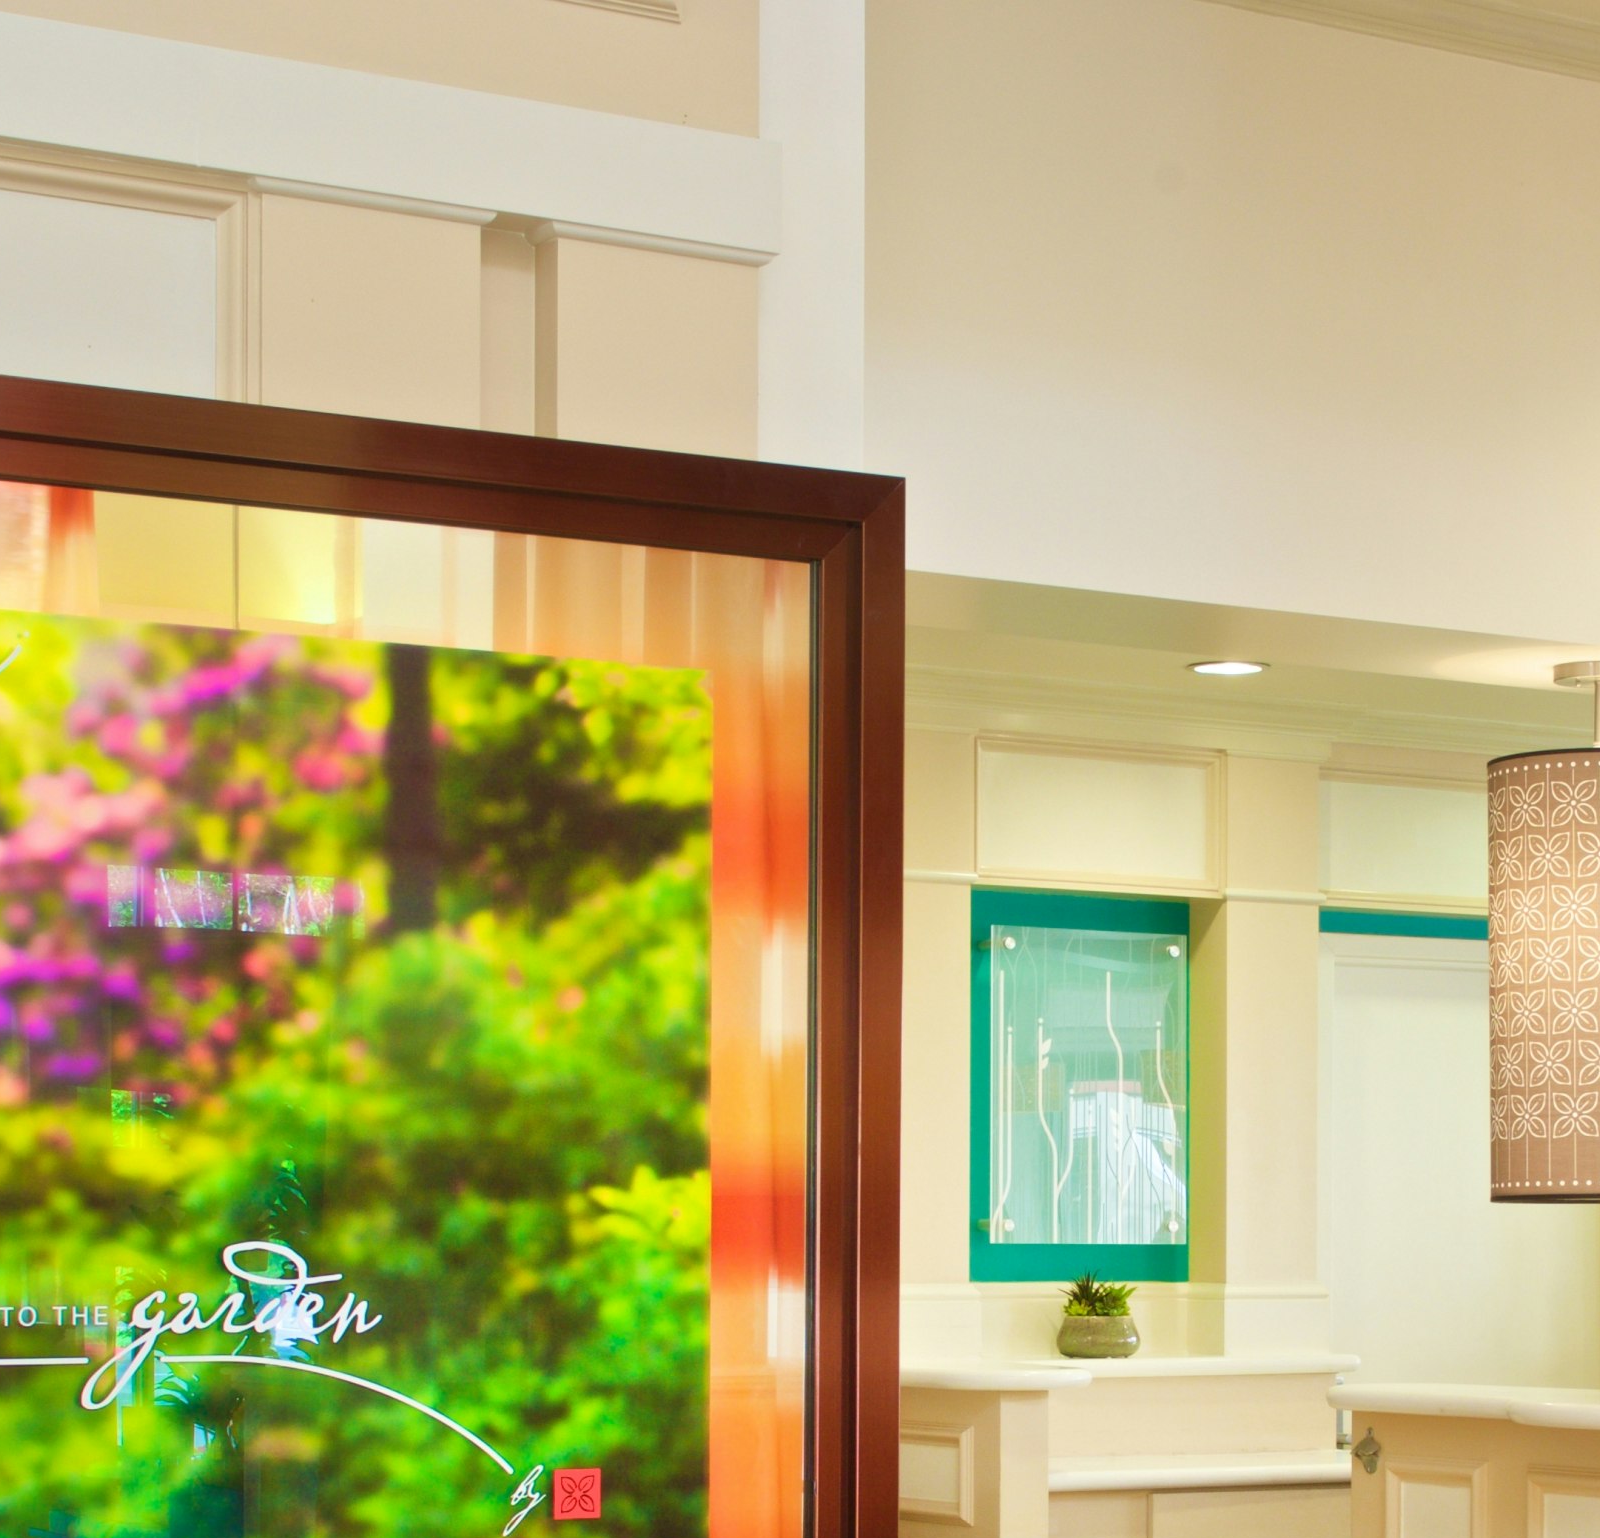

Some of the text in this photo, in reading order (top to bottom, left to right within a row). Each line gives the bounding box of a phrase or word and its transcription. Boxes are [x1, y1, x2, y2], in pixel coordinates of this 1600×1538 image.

[0, 1305, 39, 1328] TO
[52, 1305, 109, 1327] THE
[81, 1241, 384, 1411] garden
[503, 1464, 547, 1537] by
